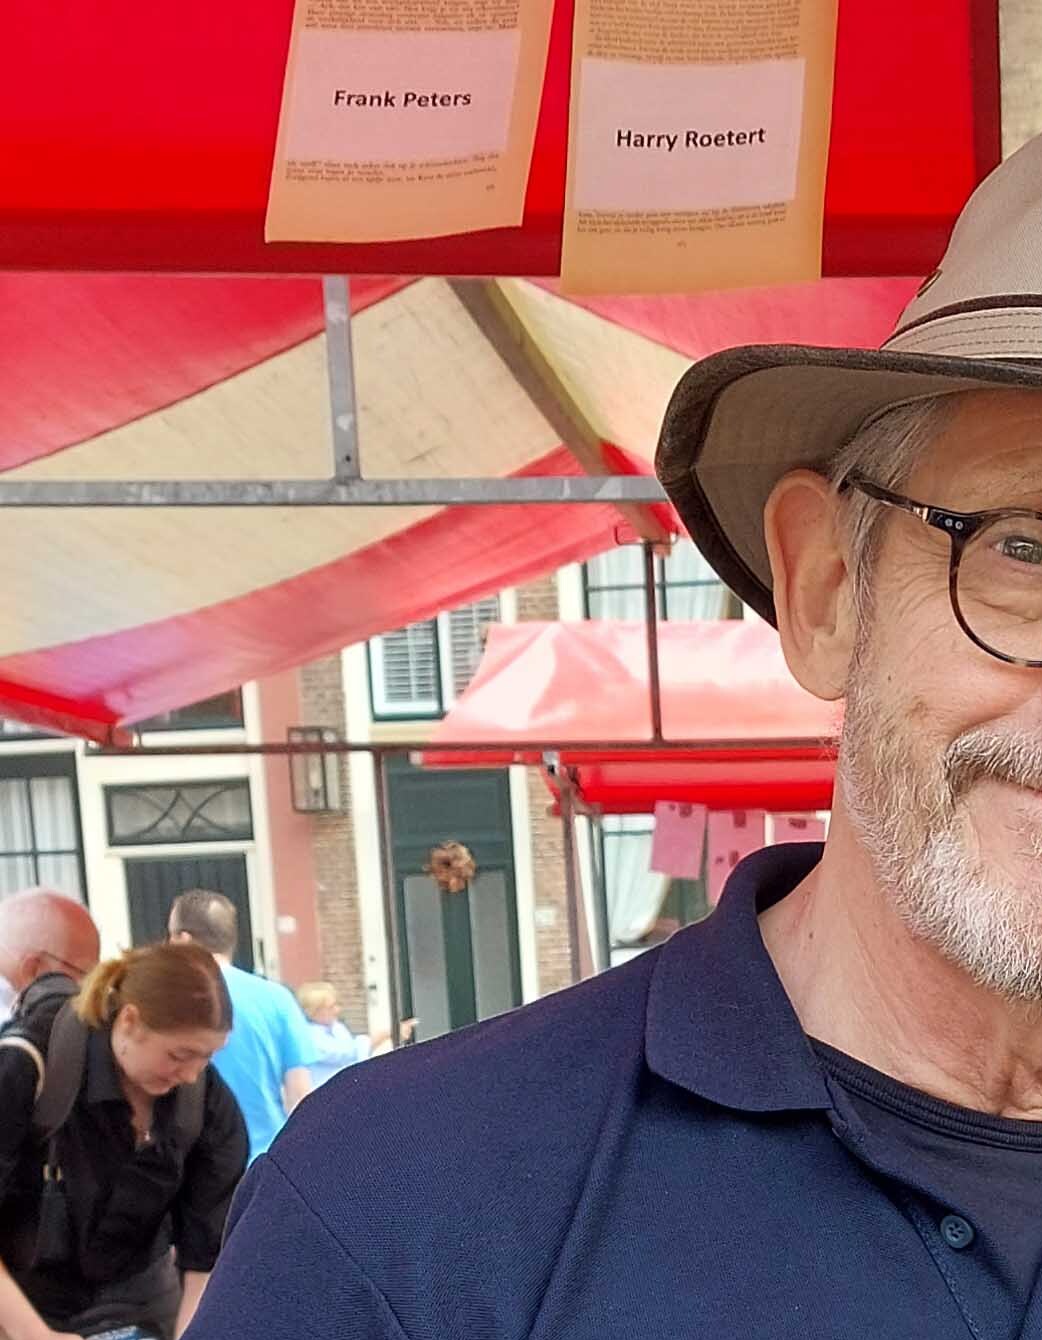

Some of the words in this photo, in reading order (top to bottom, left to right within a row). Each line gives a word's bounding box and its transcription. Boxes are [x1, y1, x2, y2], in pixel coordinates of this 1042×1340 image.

[334, 90, 395, 108] Frank
[403, 90, 472, 109] Peters
[616, 129, 678, 153] Harry
[685, 126, 766, 149] Roetert
